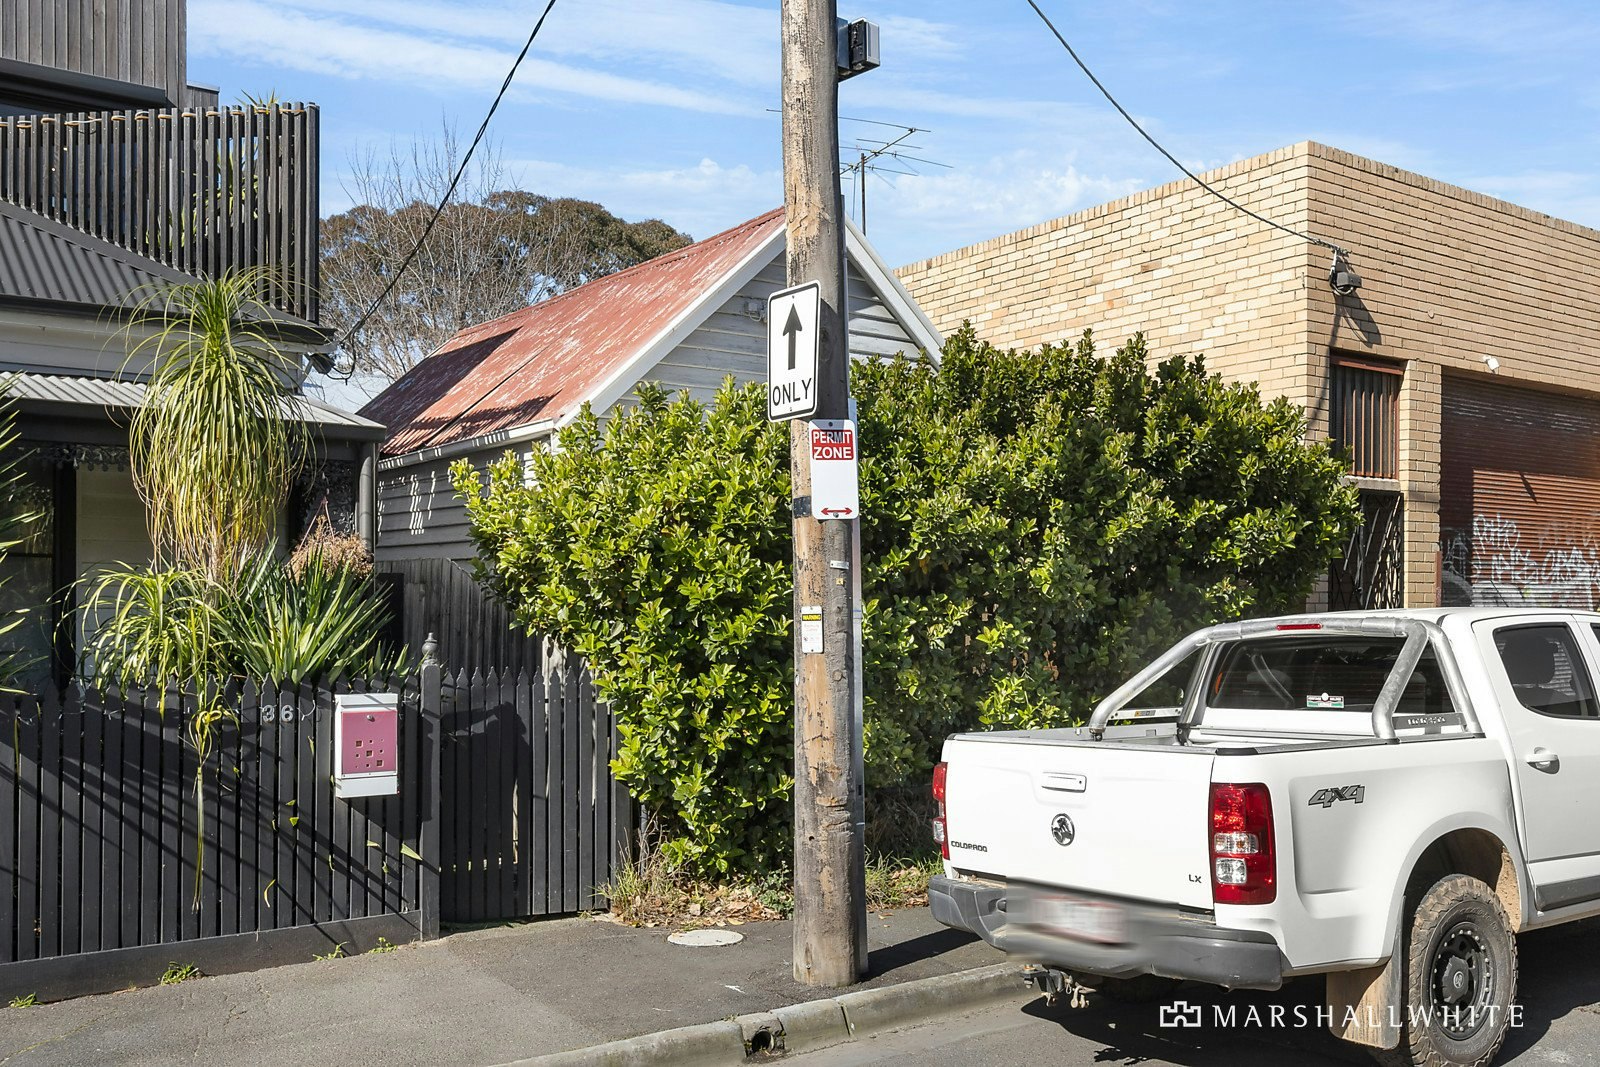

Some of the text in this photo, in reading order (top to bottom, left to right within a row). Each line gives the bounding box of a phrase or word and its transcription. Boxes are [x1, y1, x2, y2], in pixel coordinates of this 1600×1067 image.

[772, 377, 812, 406] ONLY
[812, 431, 851, 444] PERMIT
[813, 446, 852, 459] ZONE
[262, 704, 294, 722] 36
[950, 840, 988, 852] COLORADO
[1188, 873, 1202, 884] LX
